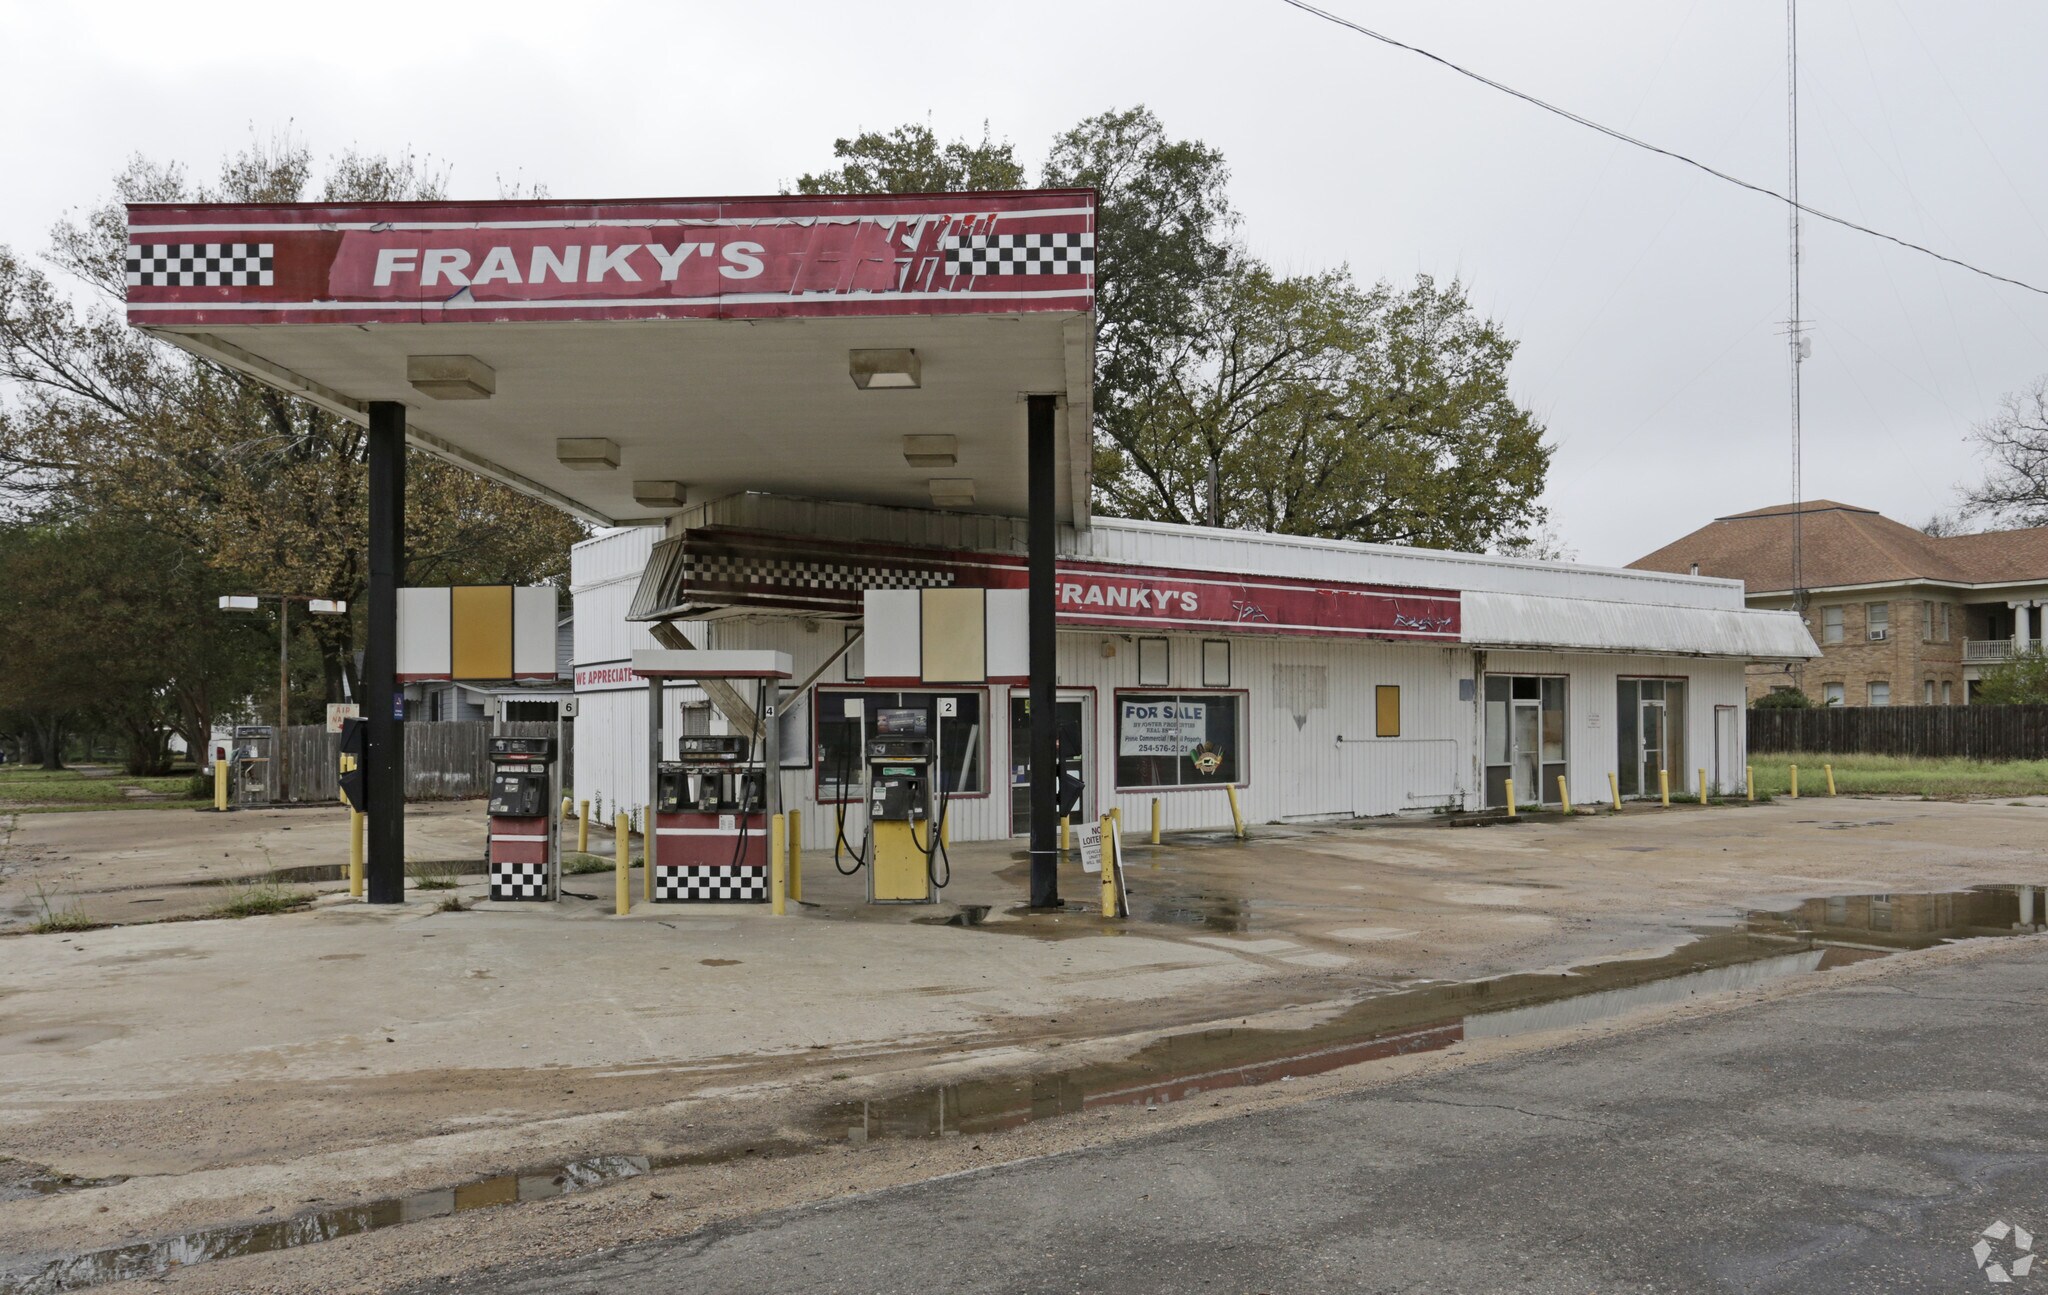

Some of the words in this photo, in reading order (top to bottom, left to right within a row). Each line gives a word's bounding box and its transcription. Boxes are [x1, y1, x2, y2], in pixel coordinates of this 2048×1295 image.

[373, 241, 765, 287] FRANKY'S
[575, 672, 586, 685] WE
[588, 667, 633, 685] APPRECIATE
[565, 702, 572, 712] 6
[766, 706, 773, 716] 4
[945, 703, 952, 712] 2
[1125, 705, 1158, 719] FOR
[1163, 705, 1203, 720] SALE
[1138, 744, 1188, 752] 254-576-221
